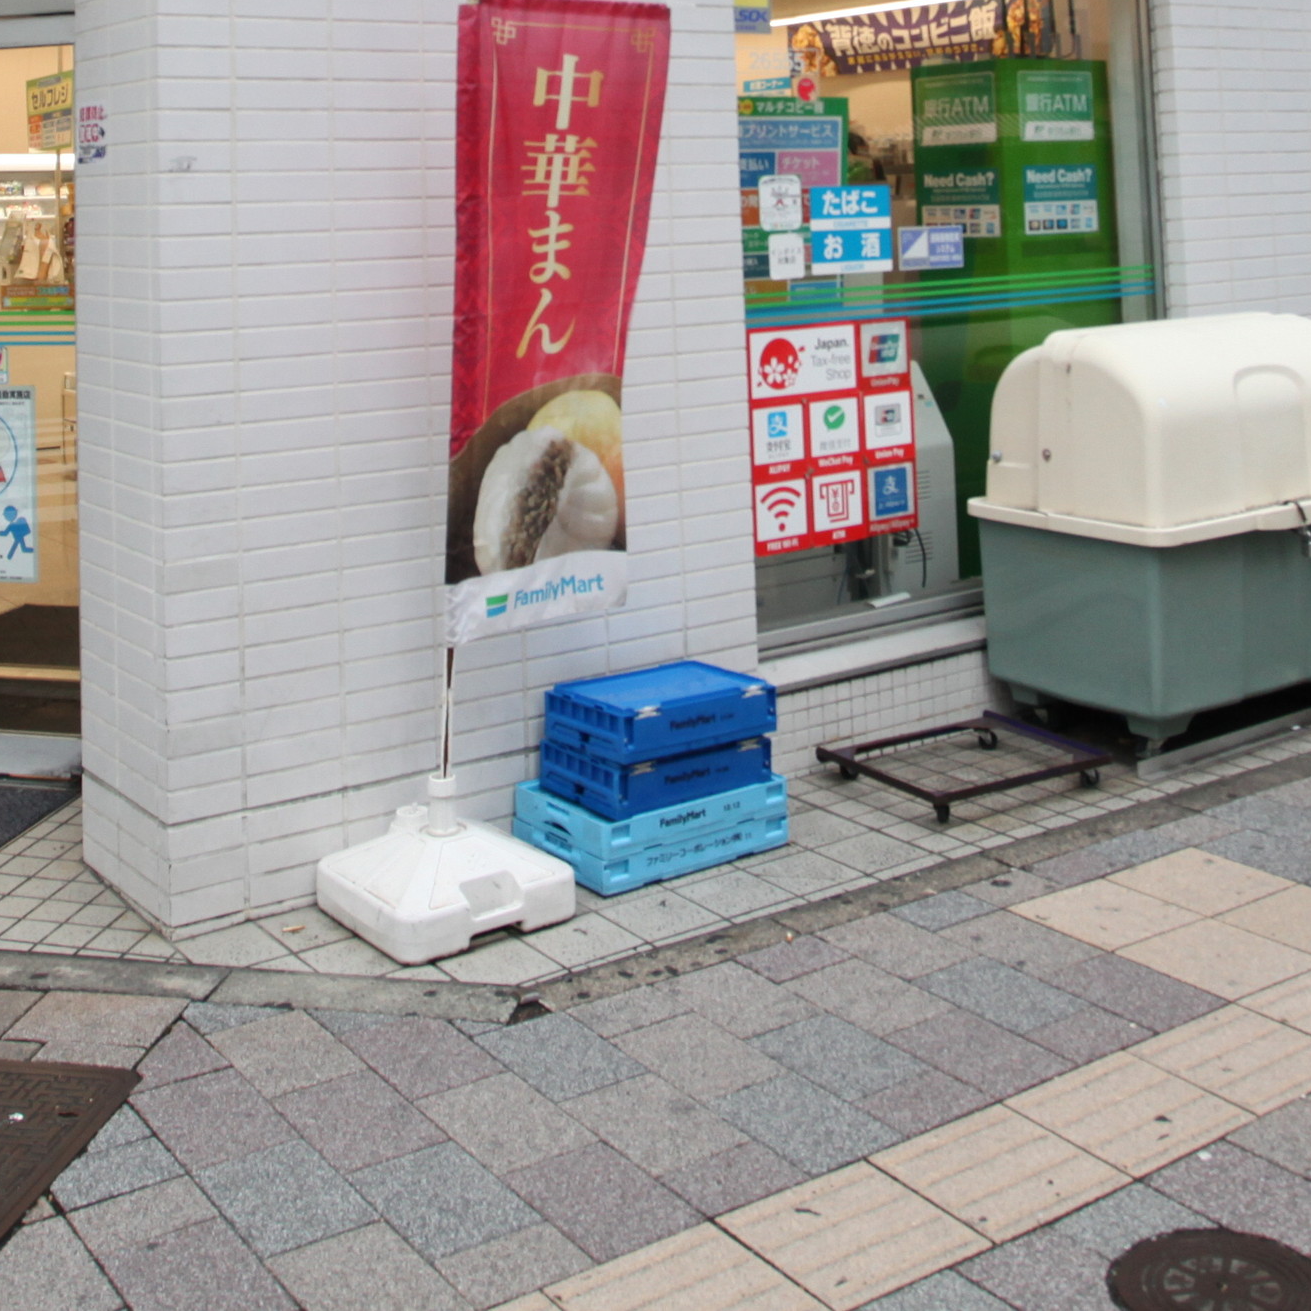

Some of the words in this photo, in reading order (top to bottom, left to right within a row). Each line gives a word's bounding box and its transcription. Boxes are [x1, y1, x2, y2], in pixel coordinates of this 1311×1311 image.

[735, 5, 769, 24] SOK
[827, 1, 997, 56] 背徳のコンビニ飯
[31, 82, 69, 110] セルフレジ
[1025, 93, 1087, 112] 銀行ATM
[923, 173, 954, 187] Need
[1025, 168, 1056, 183] Need
[1056, 167, 1093, 183] Cash?
[517, 53, 605, 362] 中華まん
[822, 189, 879, 216] たばこ
[823, 231, 881, 260] お酒
[814, 338, 850, 352] Japan.
[810, 354, 852, 368] Tax-free
[825, 368, 852, 382] Shop
[514, 573, 605, 610] FamilyMart
[669, 714, 717, 731] FamilyMart
[664, 768, 711, 785] FamilyMart
[659, 808, 707, 828] FamilyMart
